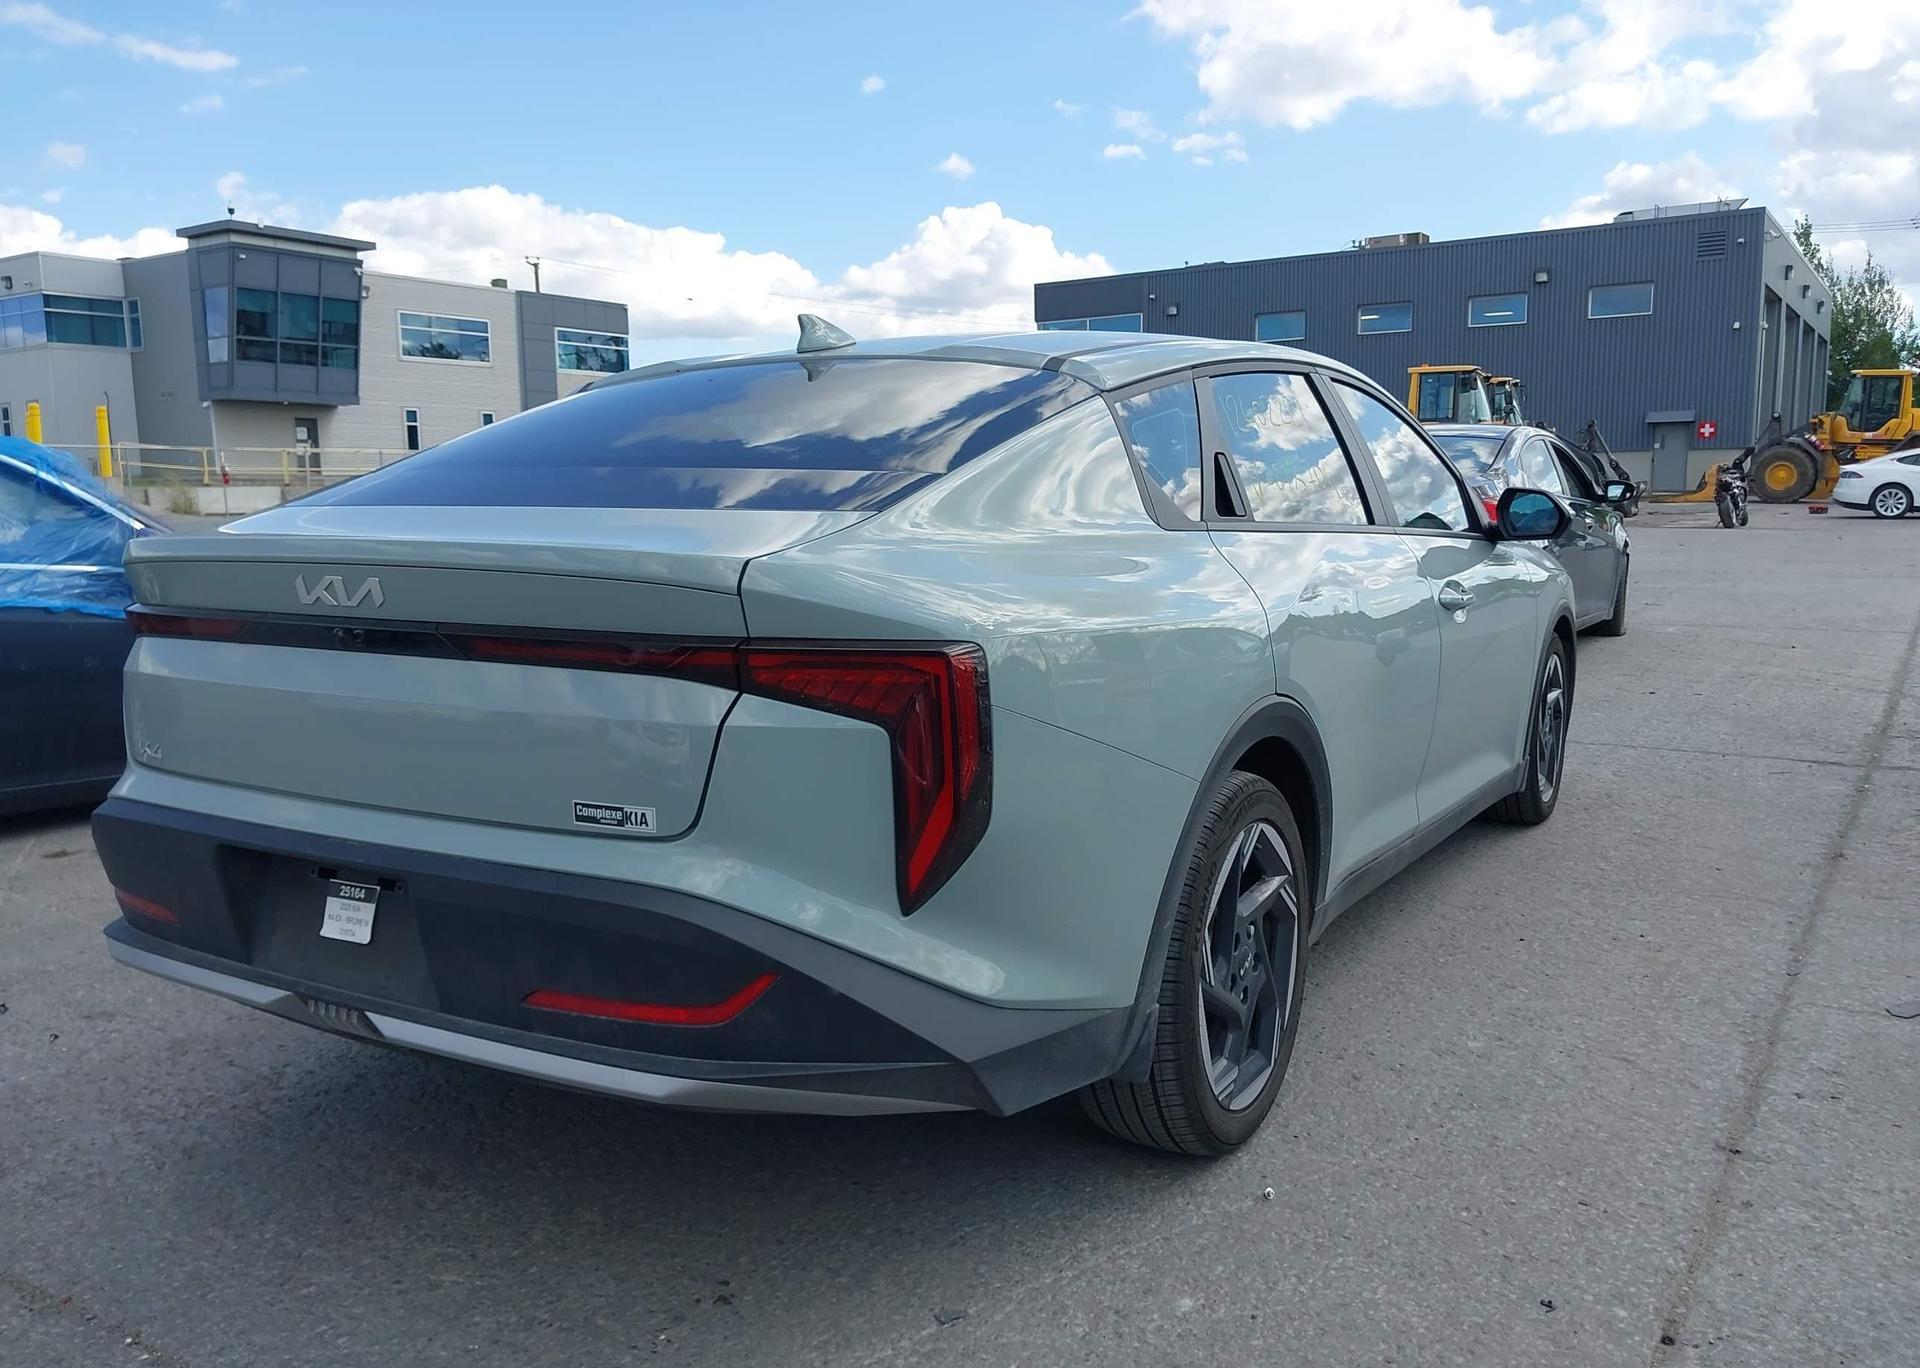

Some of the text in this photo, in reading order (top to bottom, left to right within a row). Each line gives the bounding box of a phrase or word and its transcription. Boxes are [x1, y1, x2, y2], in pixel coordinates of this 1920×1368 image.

[294, 574, 385, 608] KIA
[576, 804, 623, 820] Complexe
[625, 810, 649, 828] KIA
[340, 885, 366, 899] 25164
